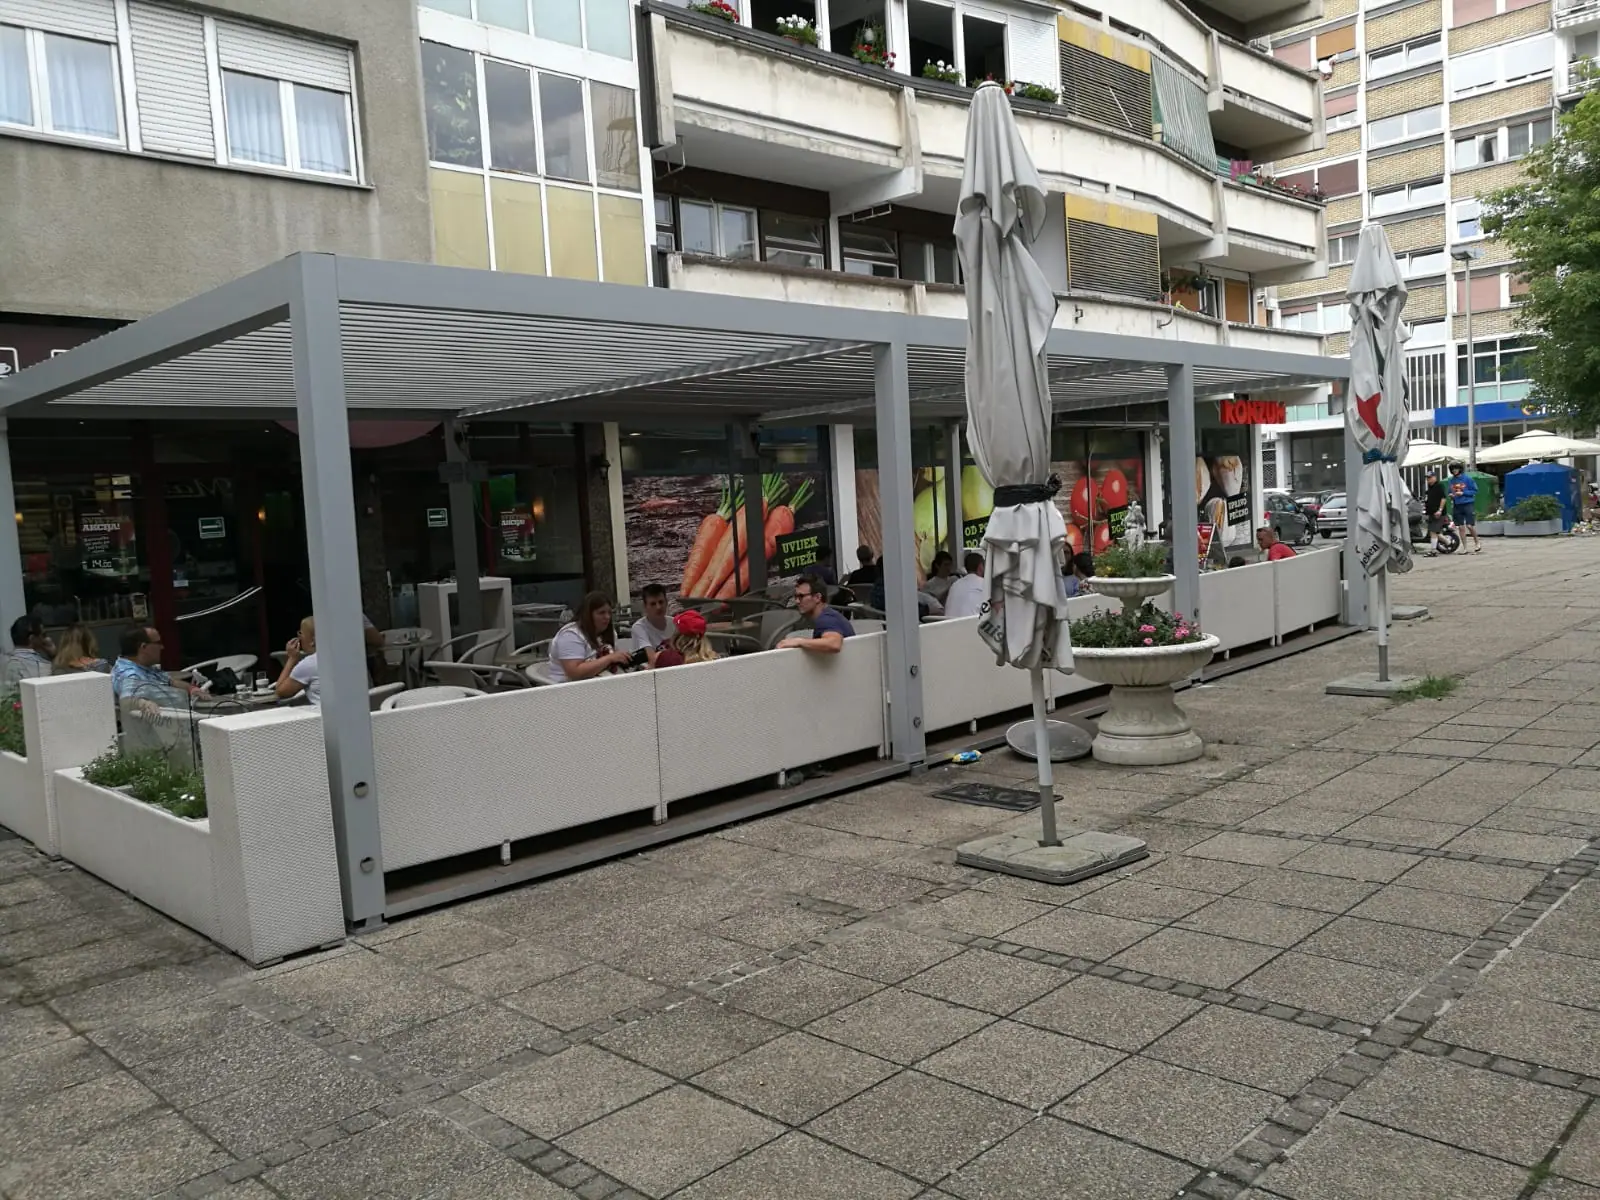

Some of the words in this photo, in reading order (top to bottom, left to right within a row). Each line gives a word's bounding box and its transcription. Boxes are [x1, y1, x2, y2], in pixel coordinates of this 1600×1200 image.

[1222, 400, 1286, 424] KONZUM
[964, 525, 978, 536] OD
[781, 535, 819, 553] UVIJEK
